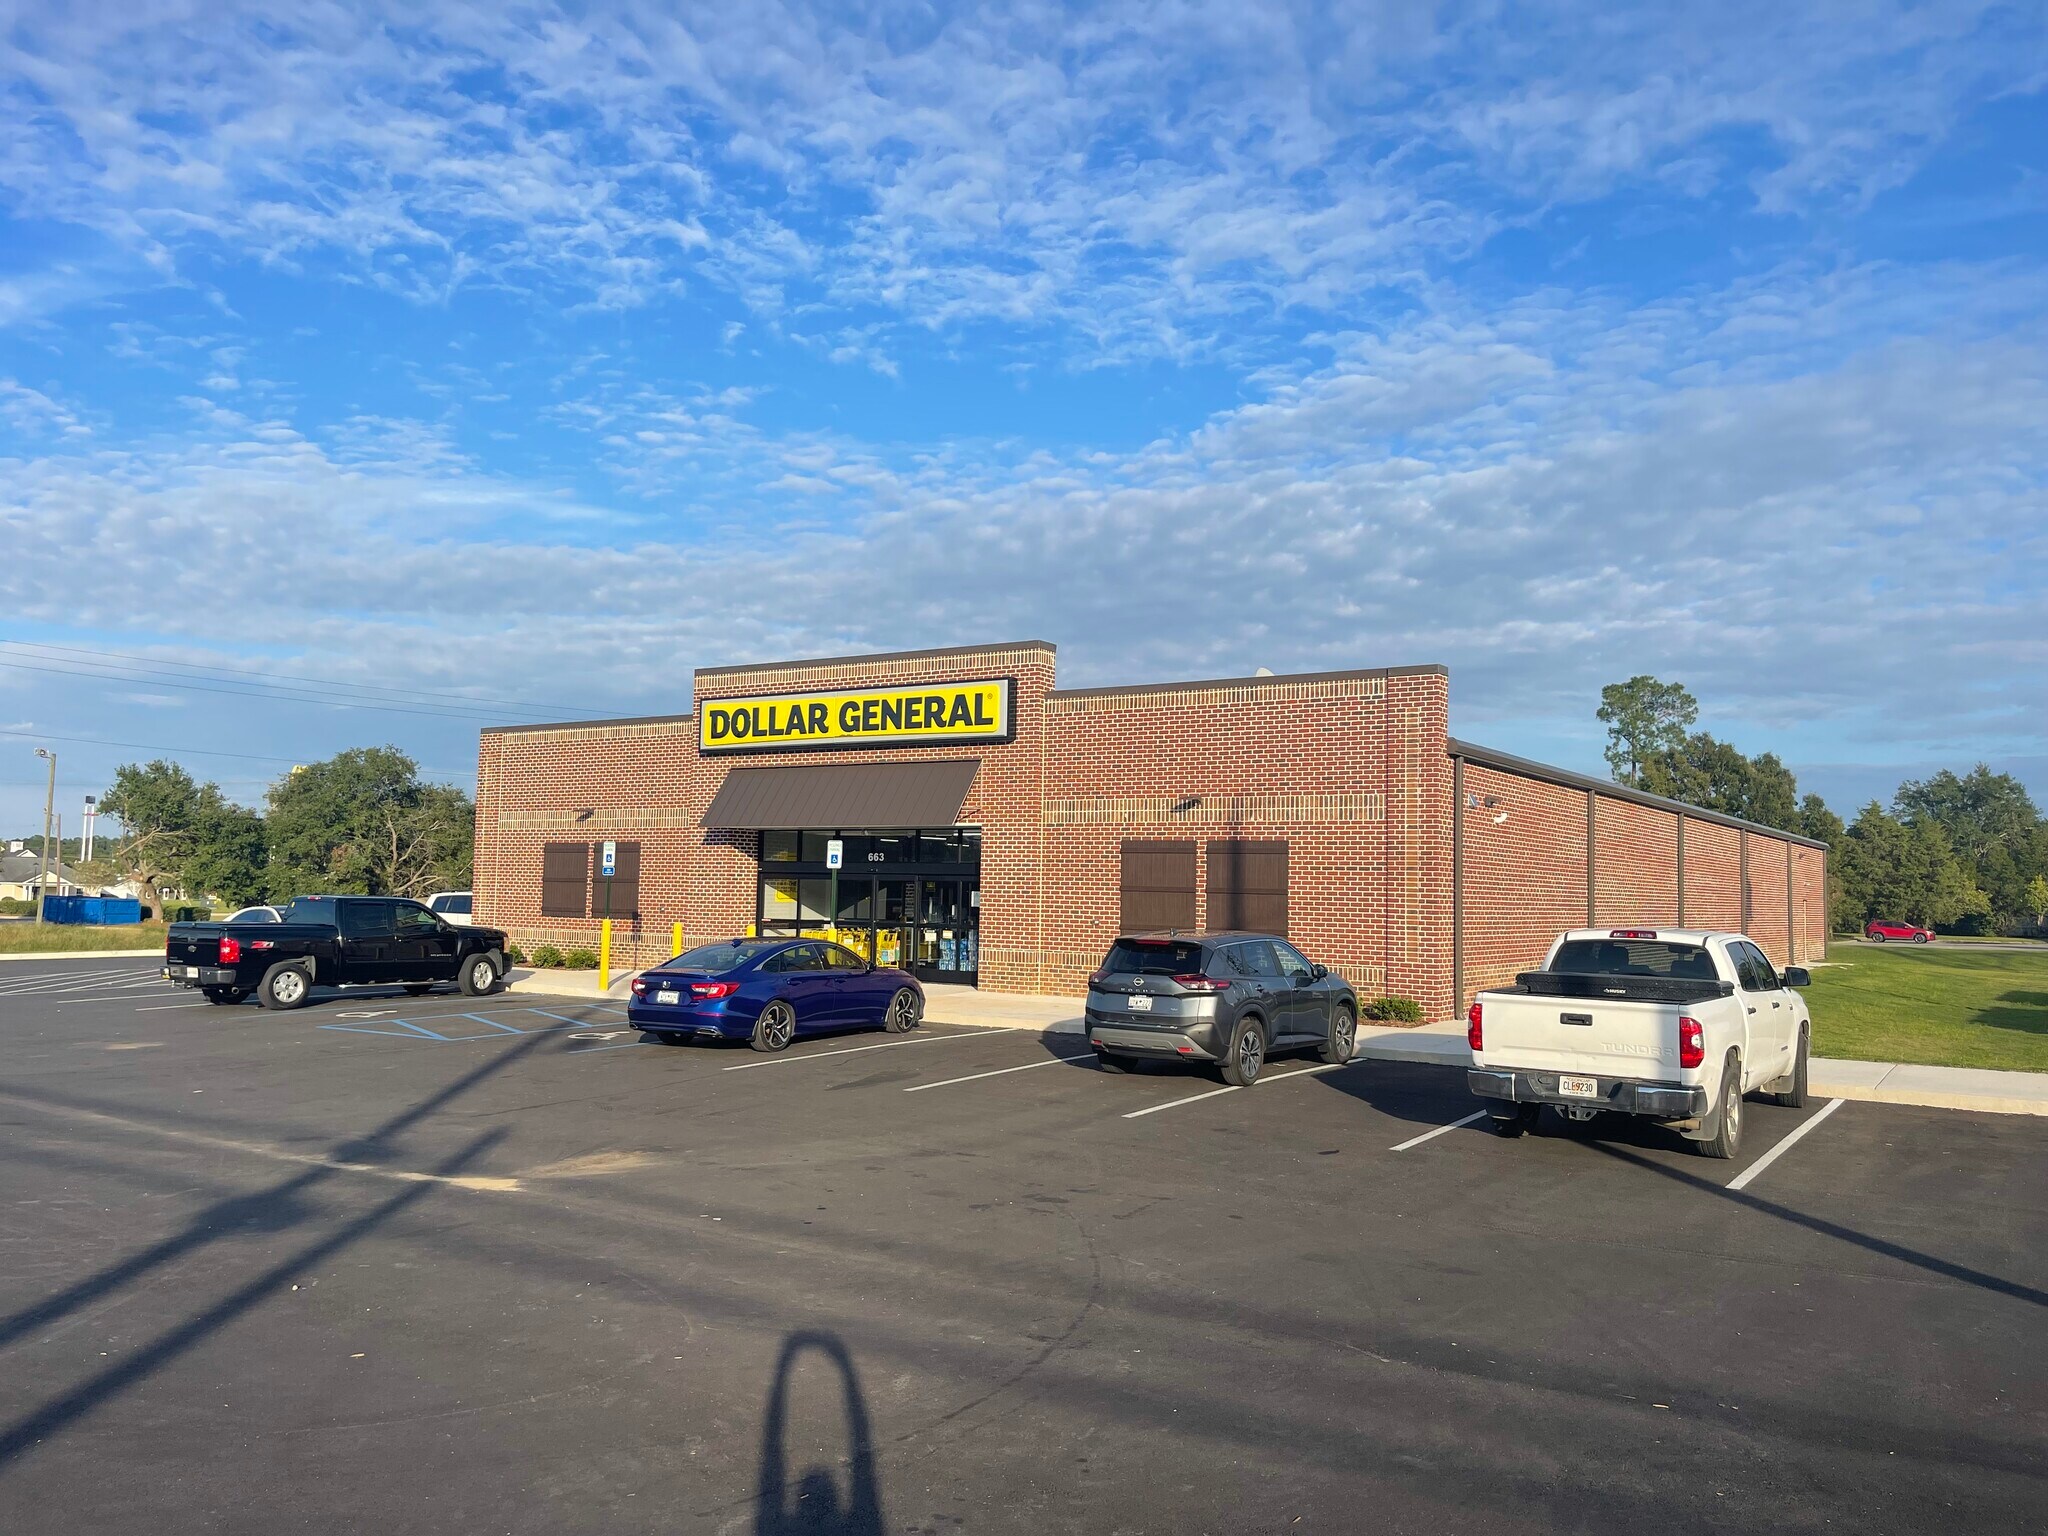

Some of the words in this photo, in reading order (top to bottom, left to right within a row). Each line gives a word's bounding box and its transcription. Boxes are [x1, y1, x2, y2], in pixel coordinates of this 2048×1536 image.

[709, 704, 829, 739] DOLLAR
[838, 692, 993, 732] GENERAL
[867, 852, 885, 861] 663
[1600, 1042, 1675, 1056] TUNDRA
